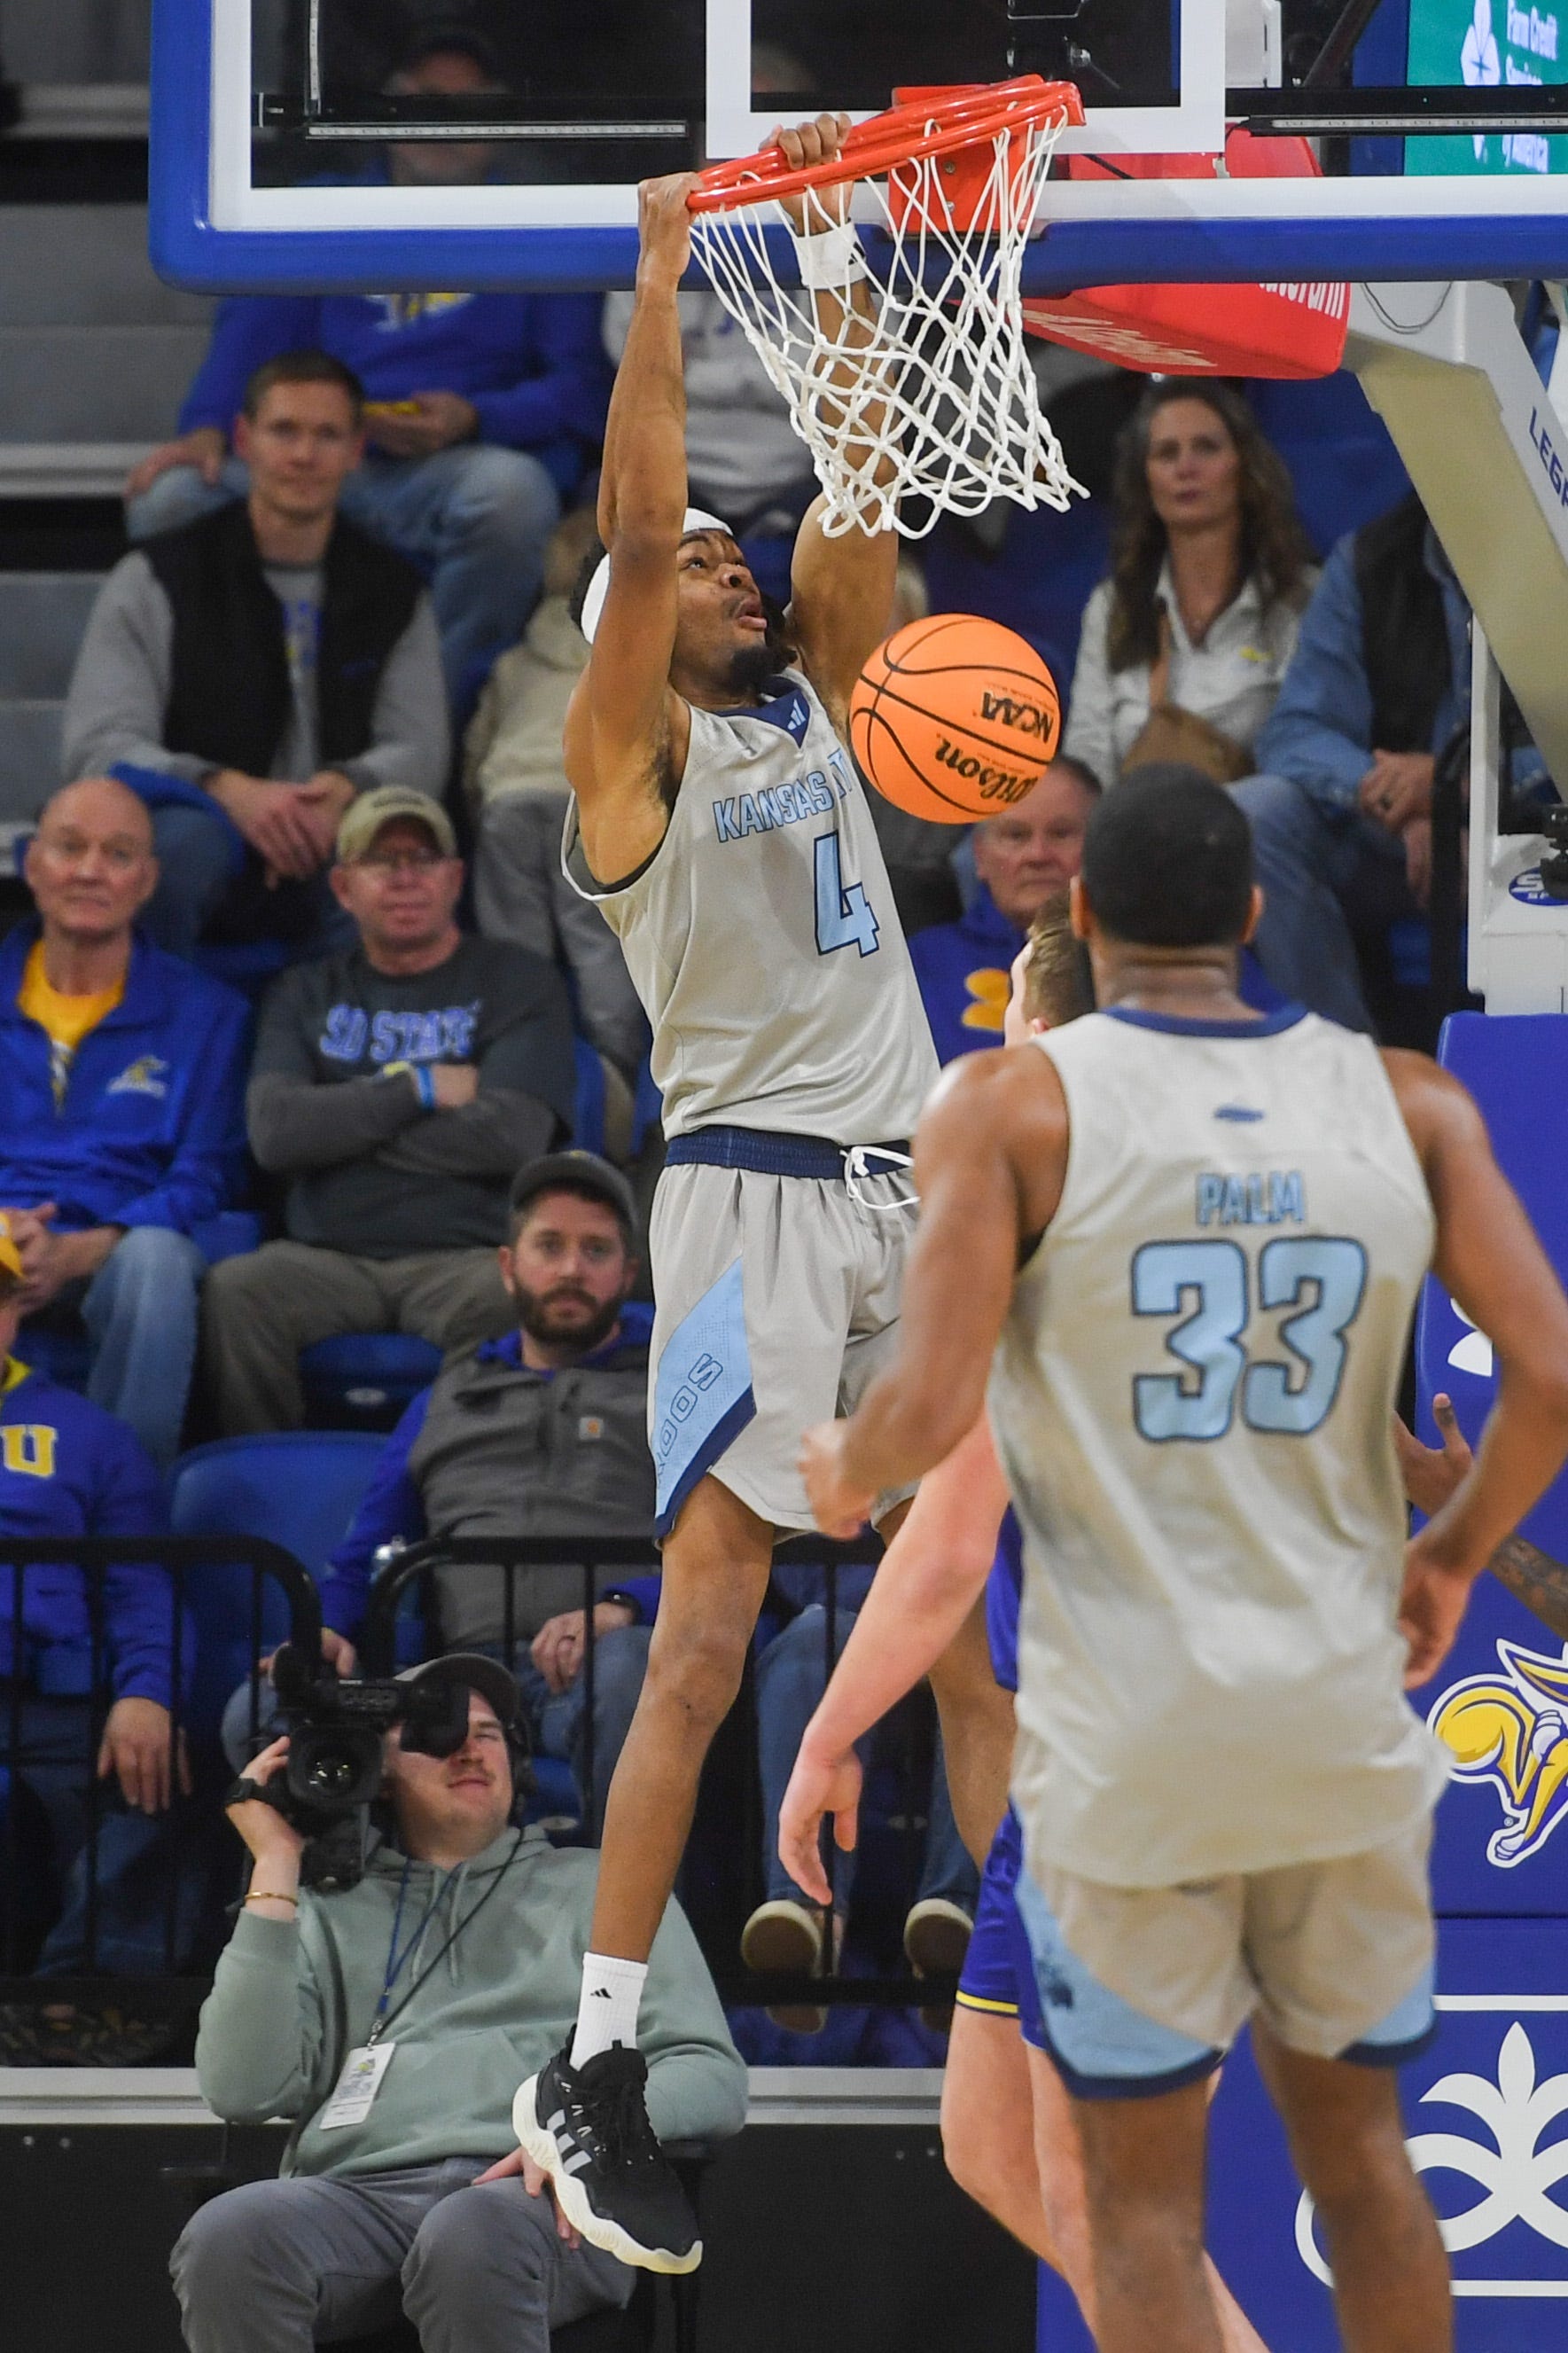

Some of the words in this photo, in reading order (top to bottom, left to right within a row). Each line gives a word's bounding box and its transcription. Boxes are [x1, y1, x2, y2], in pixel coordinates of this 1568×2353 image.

[980, 692, 1054, 744] NCAA
[713, 770, 834, 842] KANSAS
[814, 829, 880, 958] 4
[1131, 1234, 1369, 1443] 33
